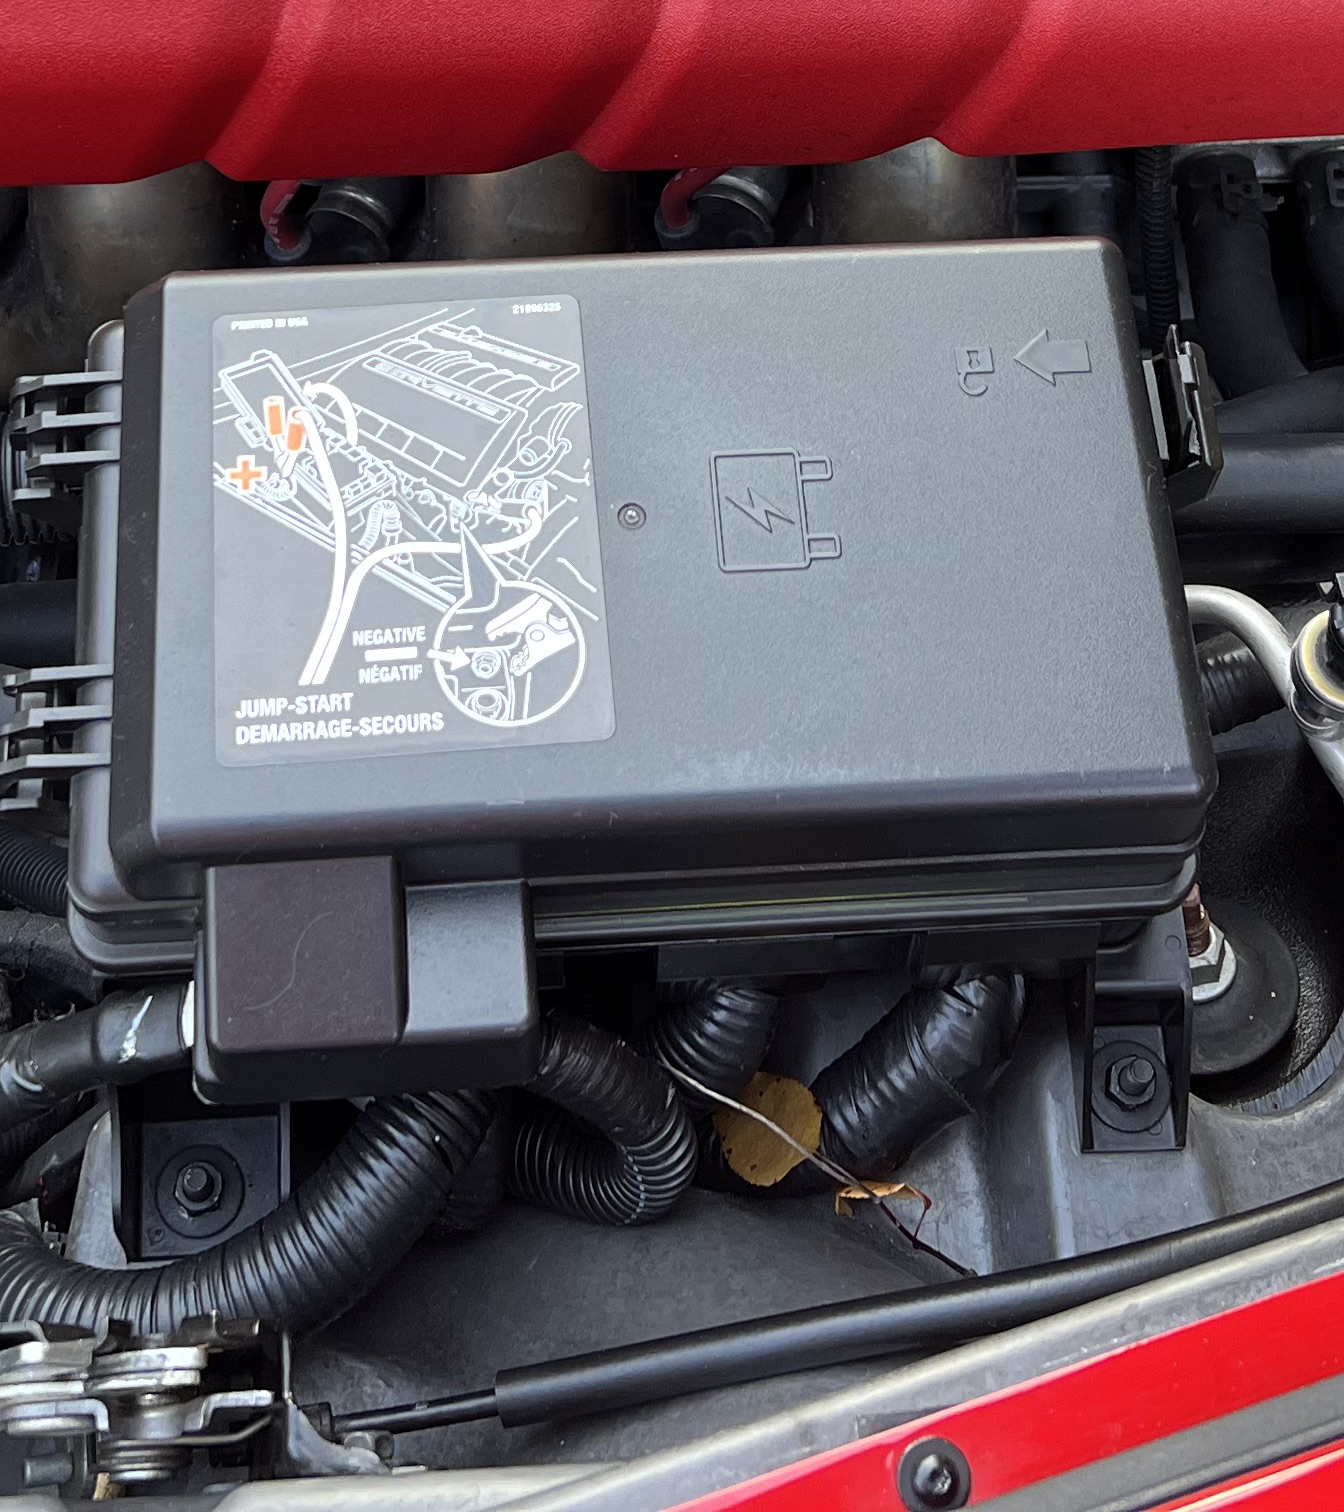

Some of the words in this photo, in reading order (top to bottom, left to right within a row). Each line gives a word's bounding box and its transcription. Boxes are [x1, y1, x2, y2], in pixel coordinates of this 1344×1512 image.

[352, 625, 426, 647] NEGATIVE
[358, 663, 423, 684] NÉGATIF
[235, 692, 354, 719] JUMP-START
[235, 711, 445, 746] DEMARRAGE-SECOURS
